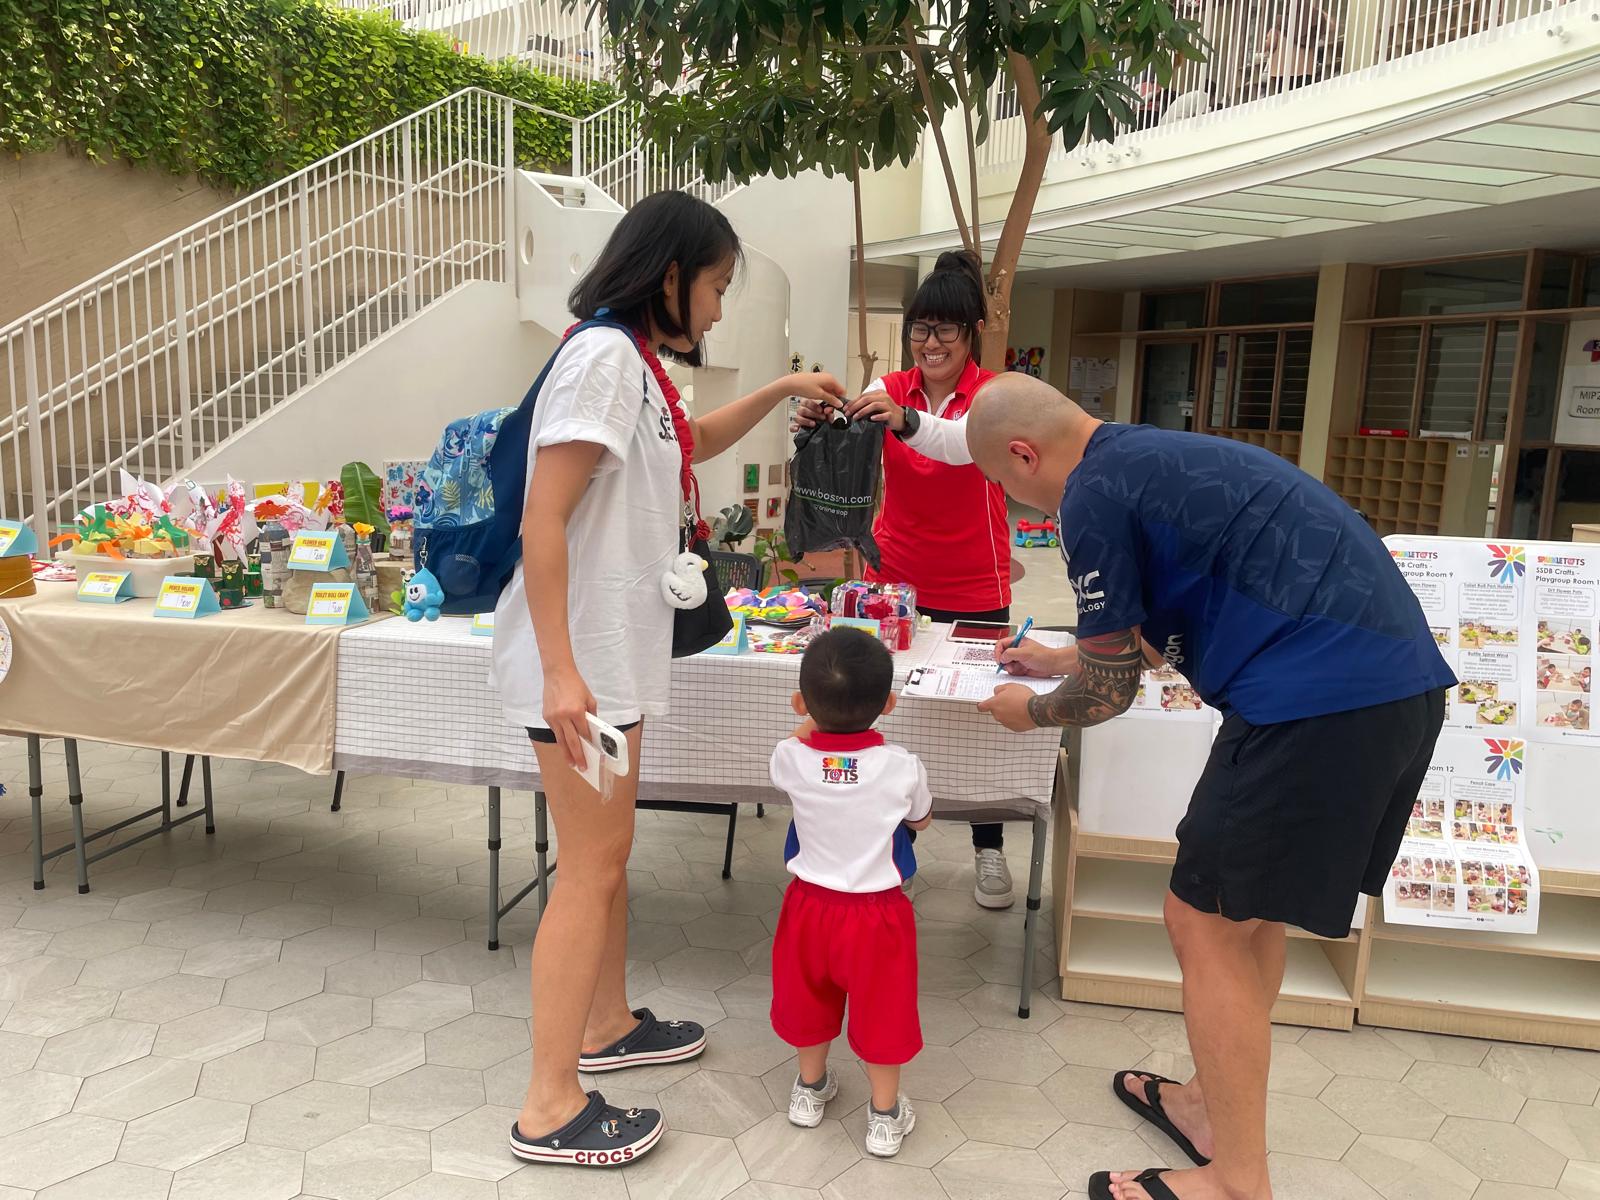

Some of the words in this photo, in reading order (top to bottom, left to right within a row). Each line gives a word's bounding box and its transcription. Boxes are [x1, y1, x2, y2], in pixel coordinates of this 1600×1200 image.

[1407, 561, 1428, 569] Crafts
[1554, 568, 1575, 576] Crafts
[1535, 575, 1571, 585] Playgroup
[574, 1147, 634, 1165] crocs
